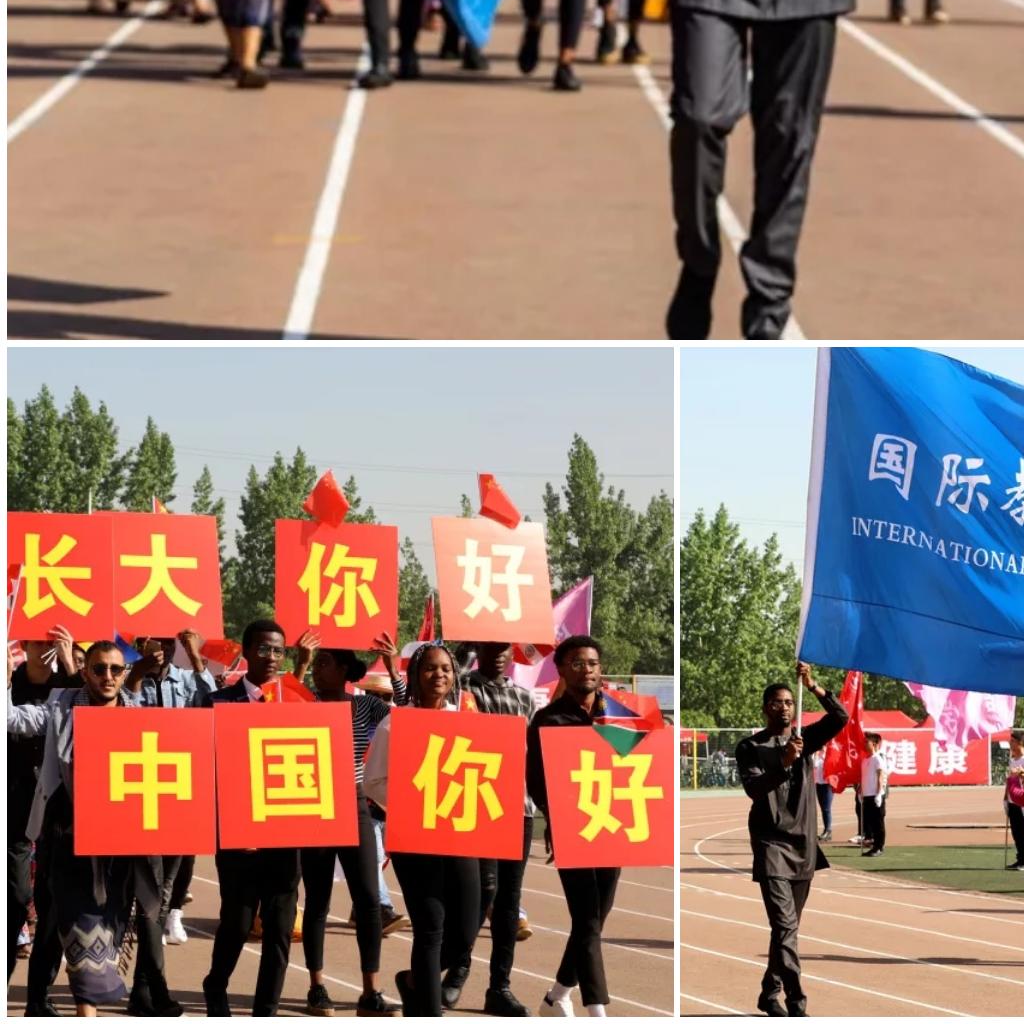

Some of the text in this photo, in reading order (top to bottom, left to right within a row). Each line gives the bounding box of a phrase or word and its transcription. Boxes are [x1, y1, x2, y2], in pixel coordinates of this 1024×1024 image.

[297, 543, 380, 628] 你
[456, 538, 534, 622] 好
[412, 734, 504, 832] 你
[570, 750, 664, 843] 好
